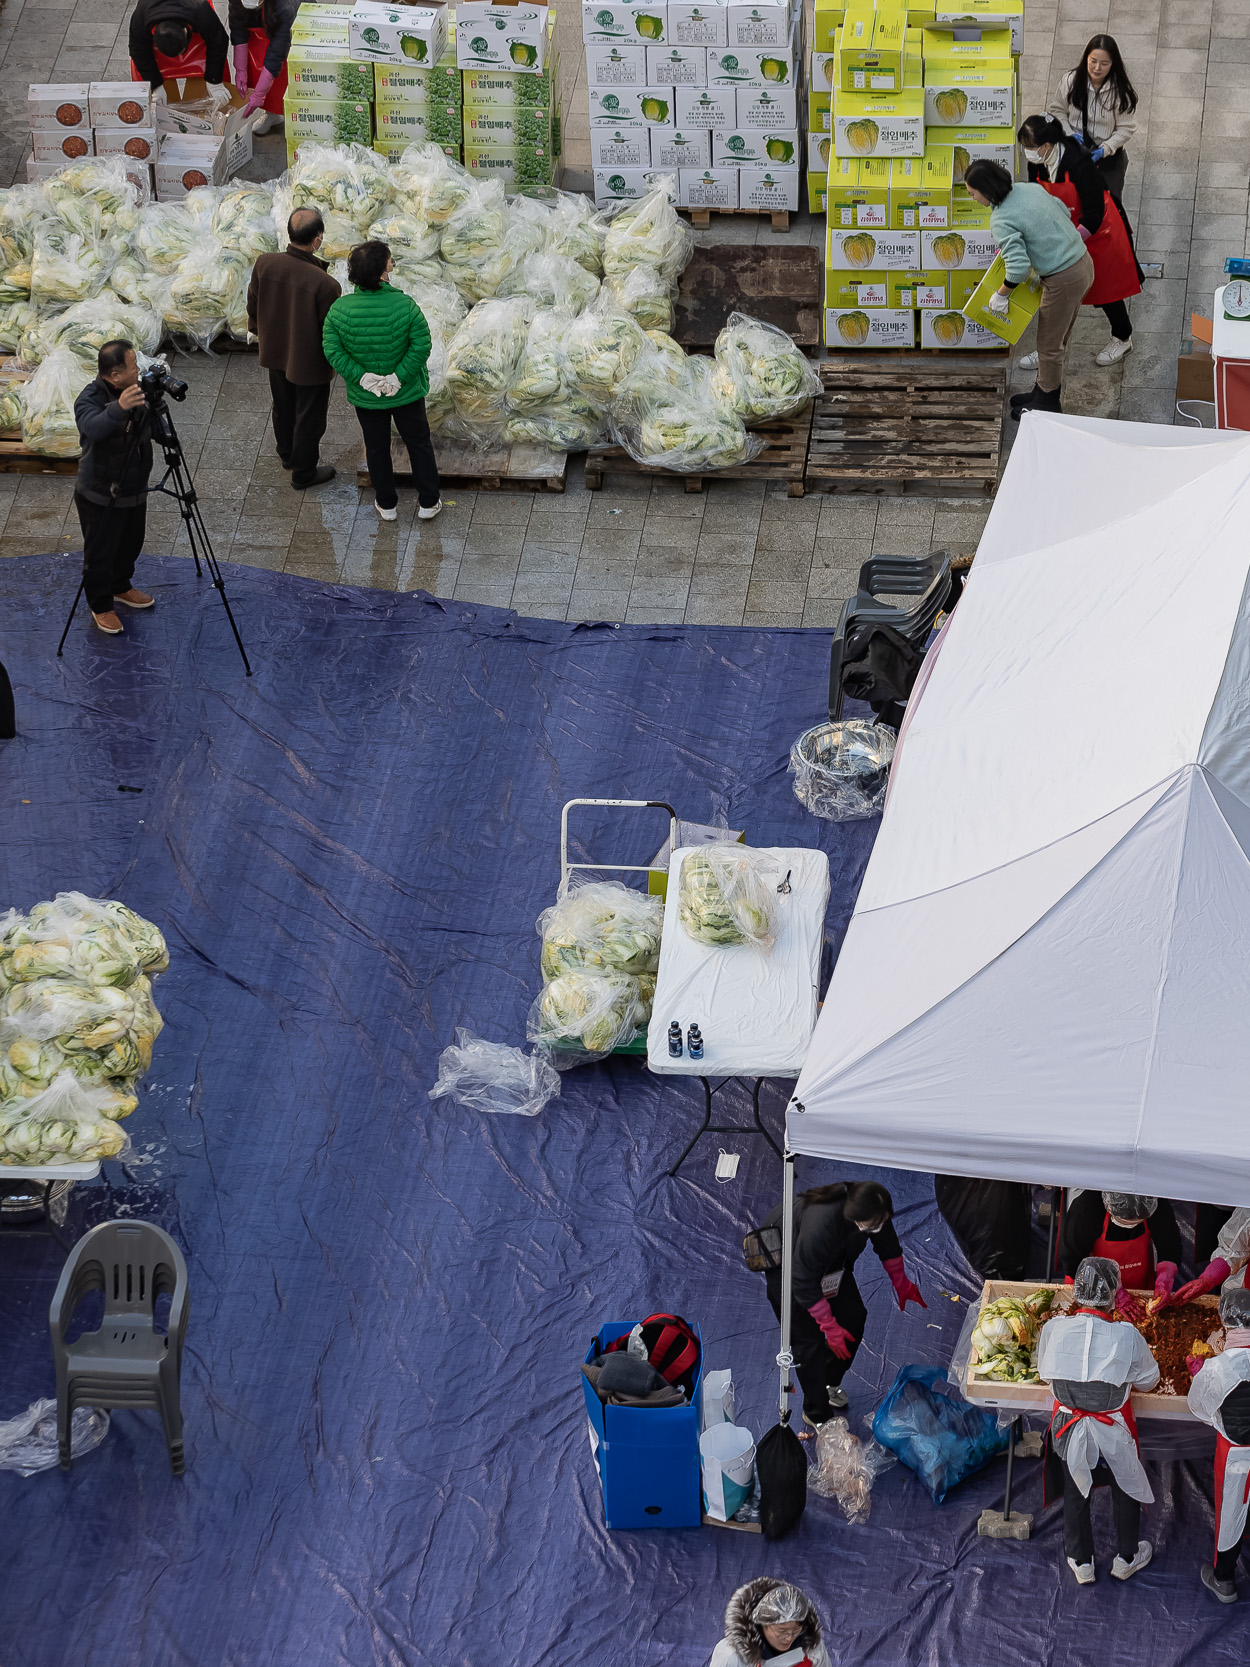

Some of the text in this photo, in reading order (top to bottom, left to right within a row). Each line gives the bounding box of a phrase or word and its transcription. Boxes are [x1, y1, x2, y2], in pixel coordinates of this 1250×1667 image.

[301, 74, 337, 83] 절임배추
[389, 78, 424, 87] 절임배추
[477, 80, 513, 90] 절임배추
[968, 100, 1007, 111] 절임배추
[298, 114, 333, 123] 절임배추
[389, 116, 425, 126] 절임배추
[477, 120, 513, 130] 절임배추
[880, 131, 919, 141] 절임배추
[478, 159, 514, 169] 절임배추
[876, 244, 915, 255] 절임배추
[870, 322, 909, 333] 절임배추
